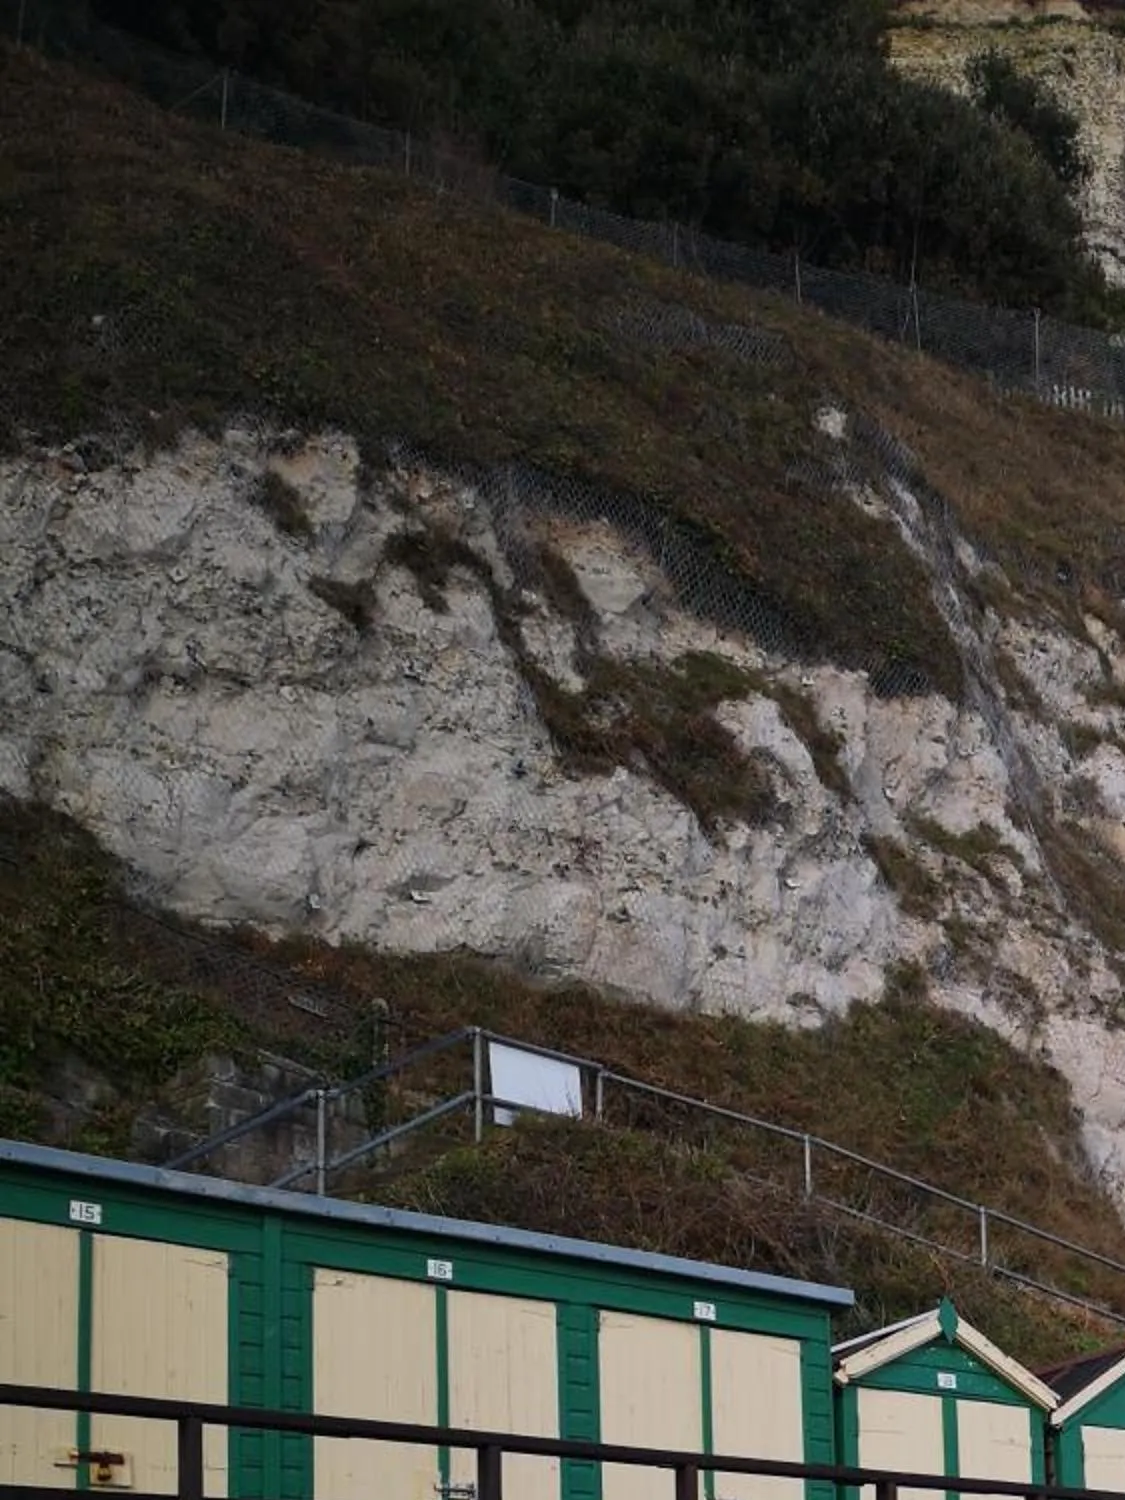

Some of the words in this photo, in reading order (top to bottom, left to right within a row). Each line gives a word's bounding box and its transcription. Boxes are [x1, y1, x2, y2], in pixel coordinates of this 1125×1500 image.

[80, 1203, 95, 1220] 15
[434, 1262, 447, 1278] 16
[699, 1304, 711, 1317] 17
